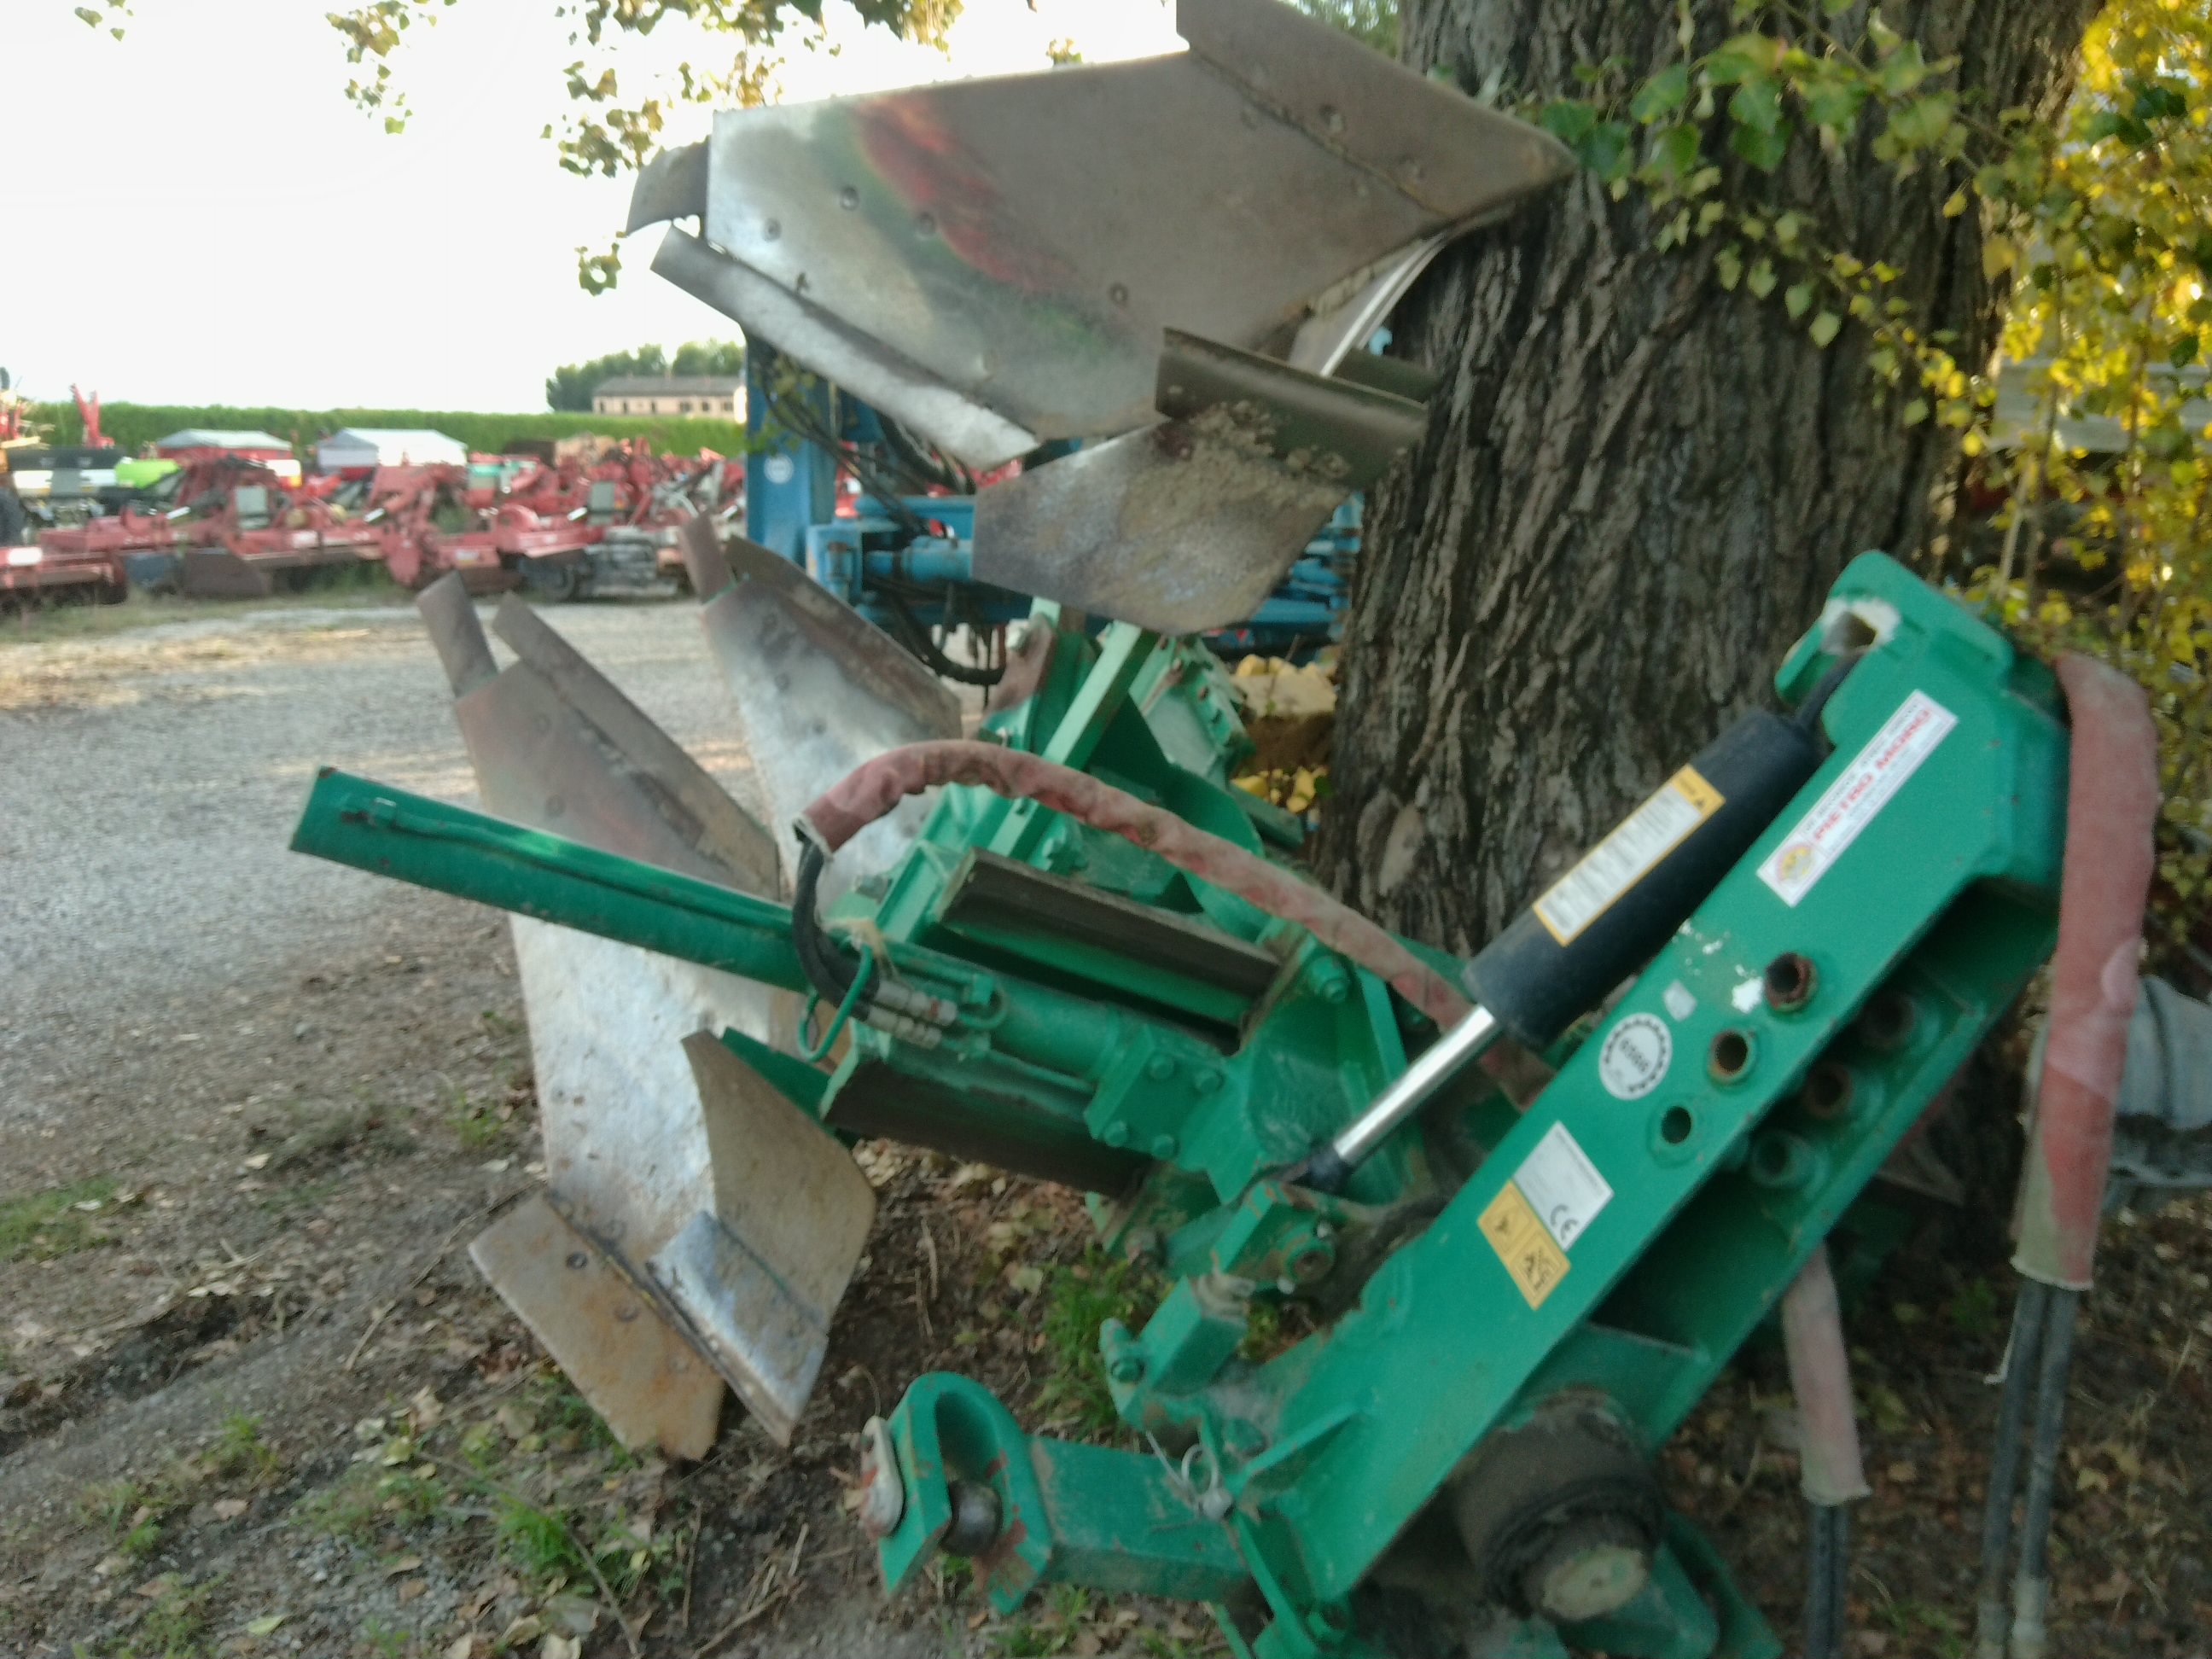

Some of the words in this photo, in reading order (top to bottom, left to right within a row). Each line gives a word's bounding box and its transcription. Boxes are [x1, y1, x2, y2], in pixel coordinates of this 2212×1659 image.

[1813, 772, 1874, 841] PIETRO
[1874, 708, 1931, 771] MORO
[1550, 1203, 1579, 1241] CE
